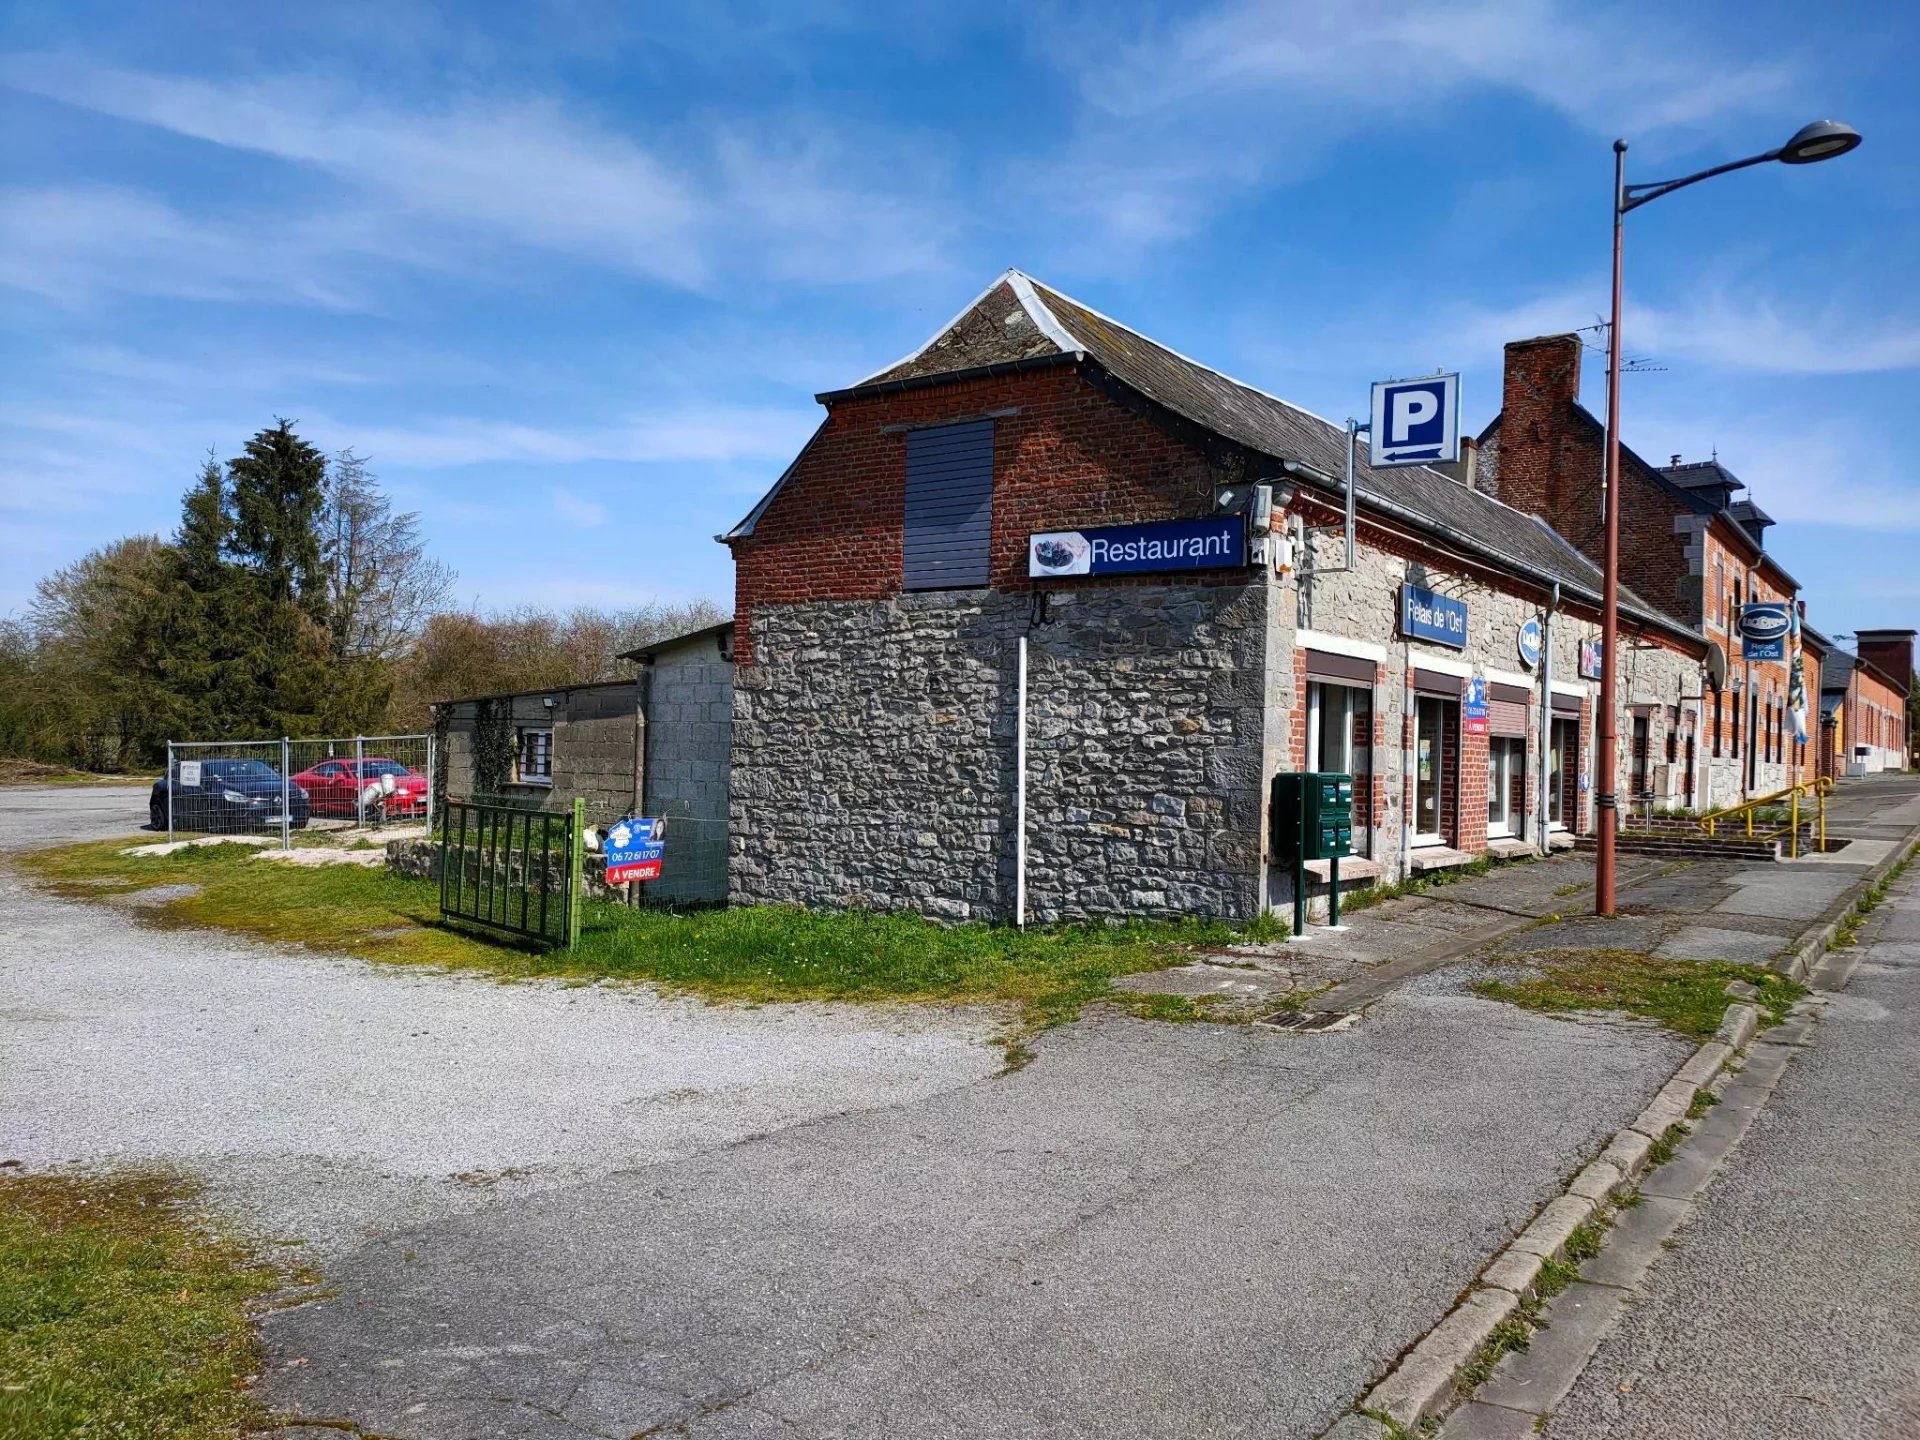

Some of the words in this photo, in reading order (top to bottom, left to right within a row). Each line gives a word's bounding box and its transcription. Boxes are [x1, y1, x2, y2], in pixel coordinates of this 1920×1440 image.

[1391, 390, 1438, 442] P
[1091, 529, 1231, 564] Restaurant
[1408, 598, 1432, 625] Relais
[1434, 606, 1445, 628] de
[612, 852, 623, 862] 06
[624, 851, 633, 861] 72
[633, 851, 641, 860] 61
[650, 850, 660, 859] 07
[622, 867, 655, 878] VENDRE
